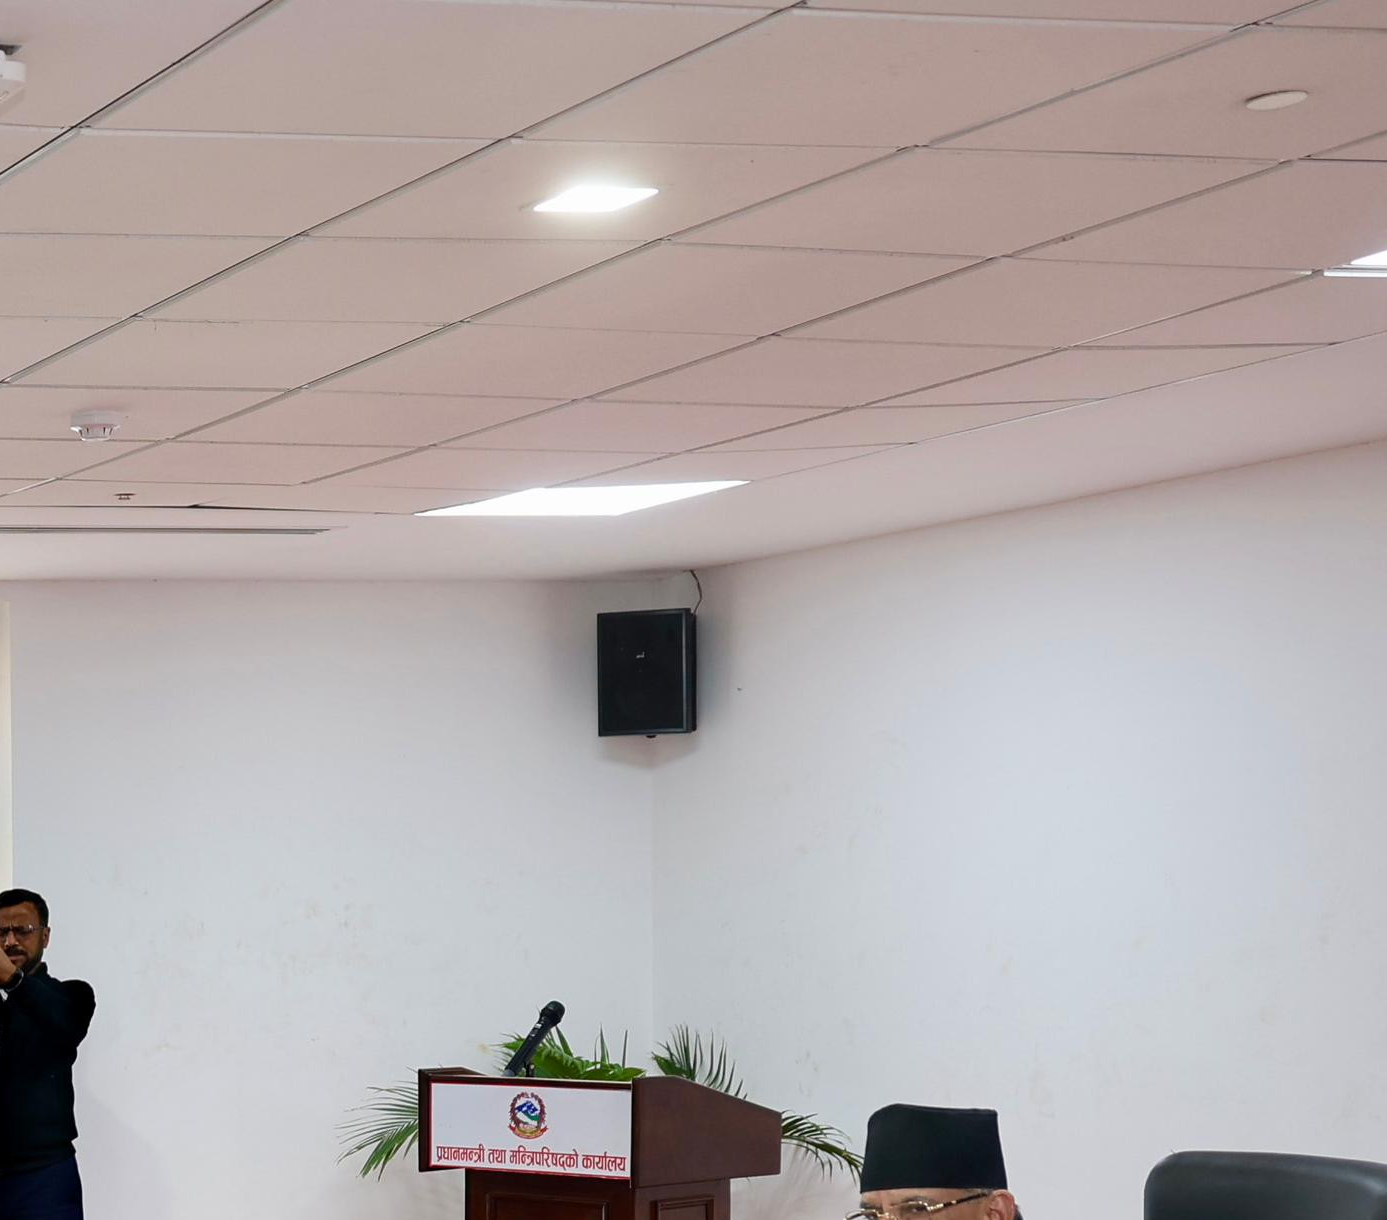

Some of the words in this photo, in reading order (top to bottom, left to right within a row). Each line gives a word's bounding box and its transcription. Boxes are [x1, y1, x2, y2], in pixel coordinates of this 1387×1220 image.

[436, 1145, 484, 1164] प्रधानमन्त्री
[488, 1149, 506, 1165] तथा
[582, 1151, 626, 1173] कार्यालय
